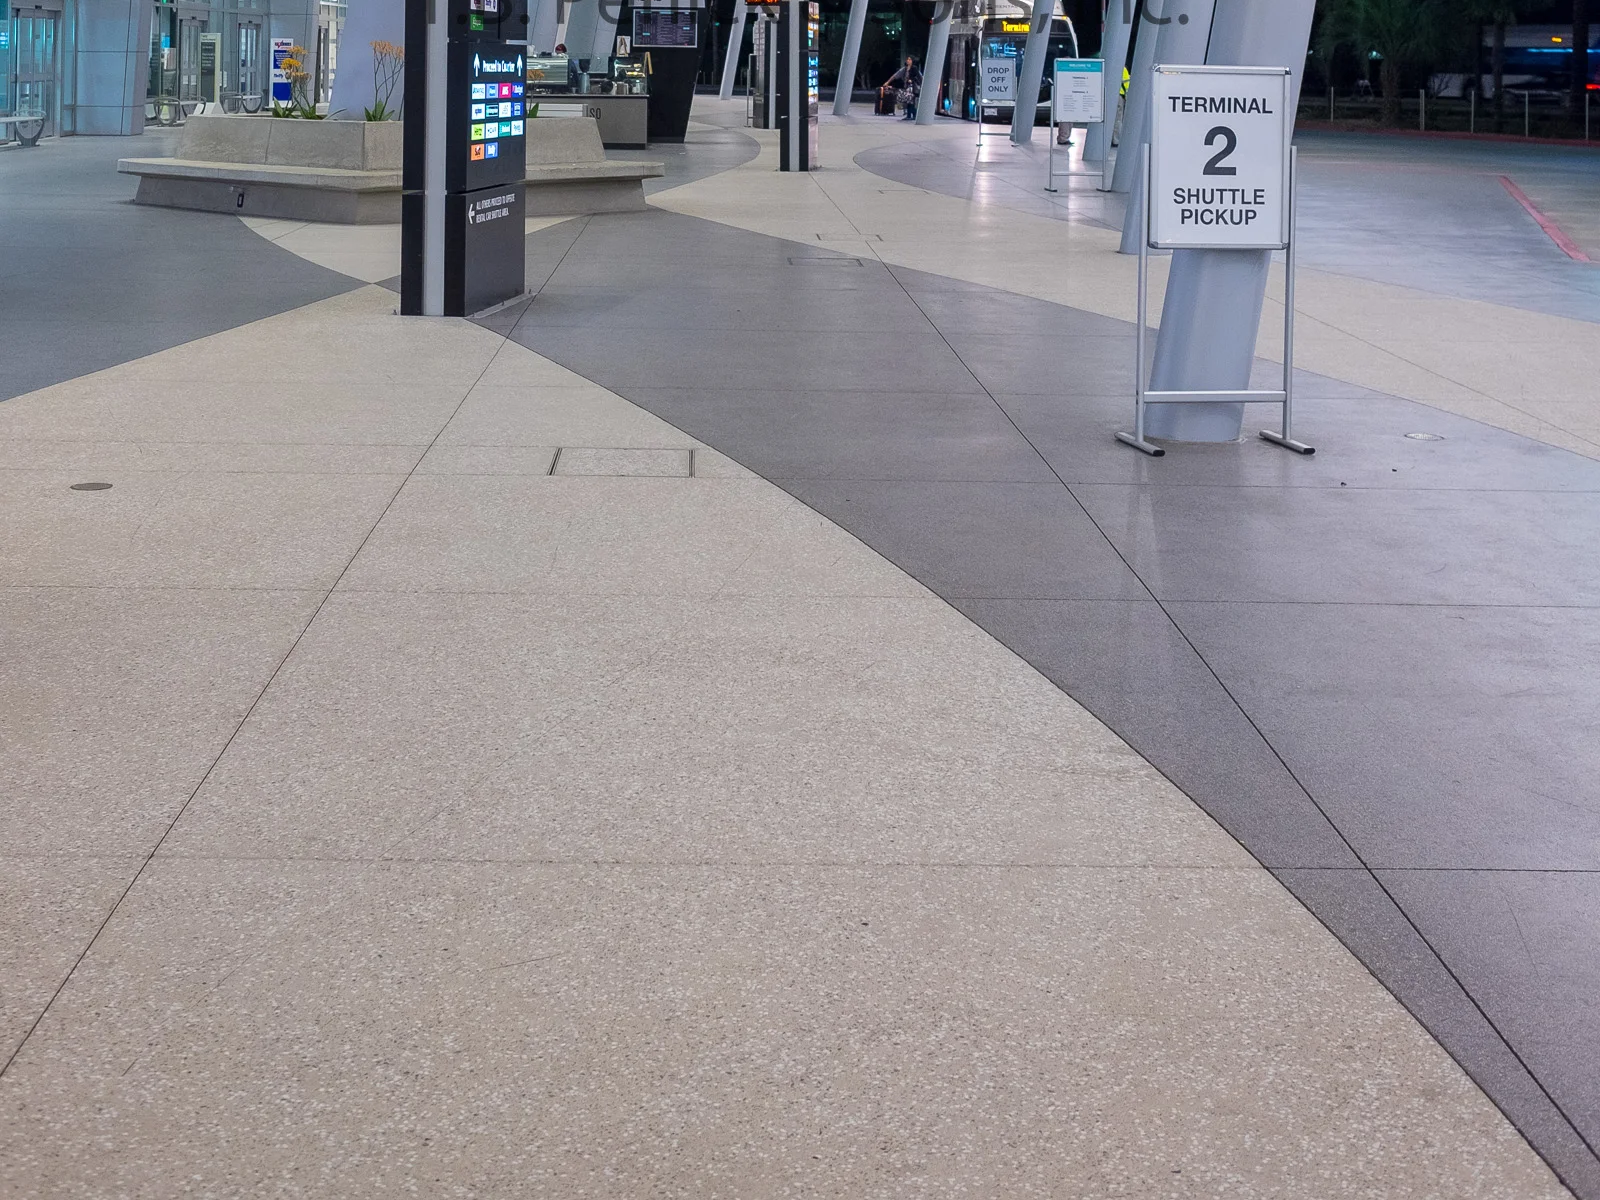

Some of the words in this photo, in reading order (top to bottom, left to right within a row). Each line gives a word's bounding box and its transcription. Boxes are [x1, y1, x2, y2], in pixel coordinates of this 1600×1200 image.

[1002, 20, 1031, 32] Termina
[1168, 96, 1273, 114] TERMINAL
[1202, 126, 1237, 176] 2
[1173, 187, 1266, 205] SHUTTLE
[1180, 208, 1257, 226] PICKUP
